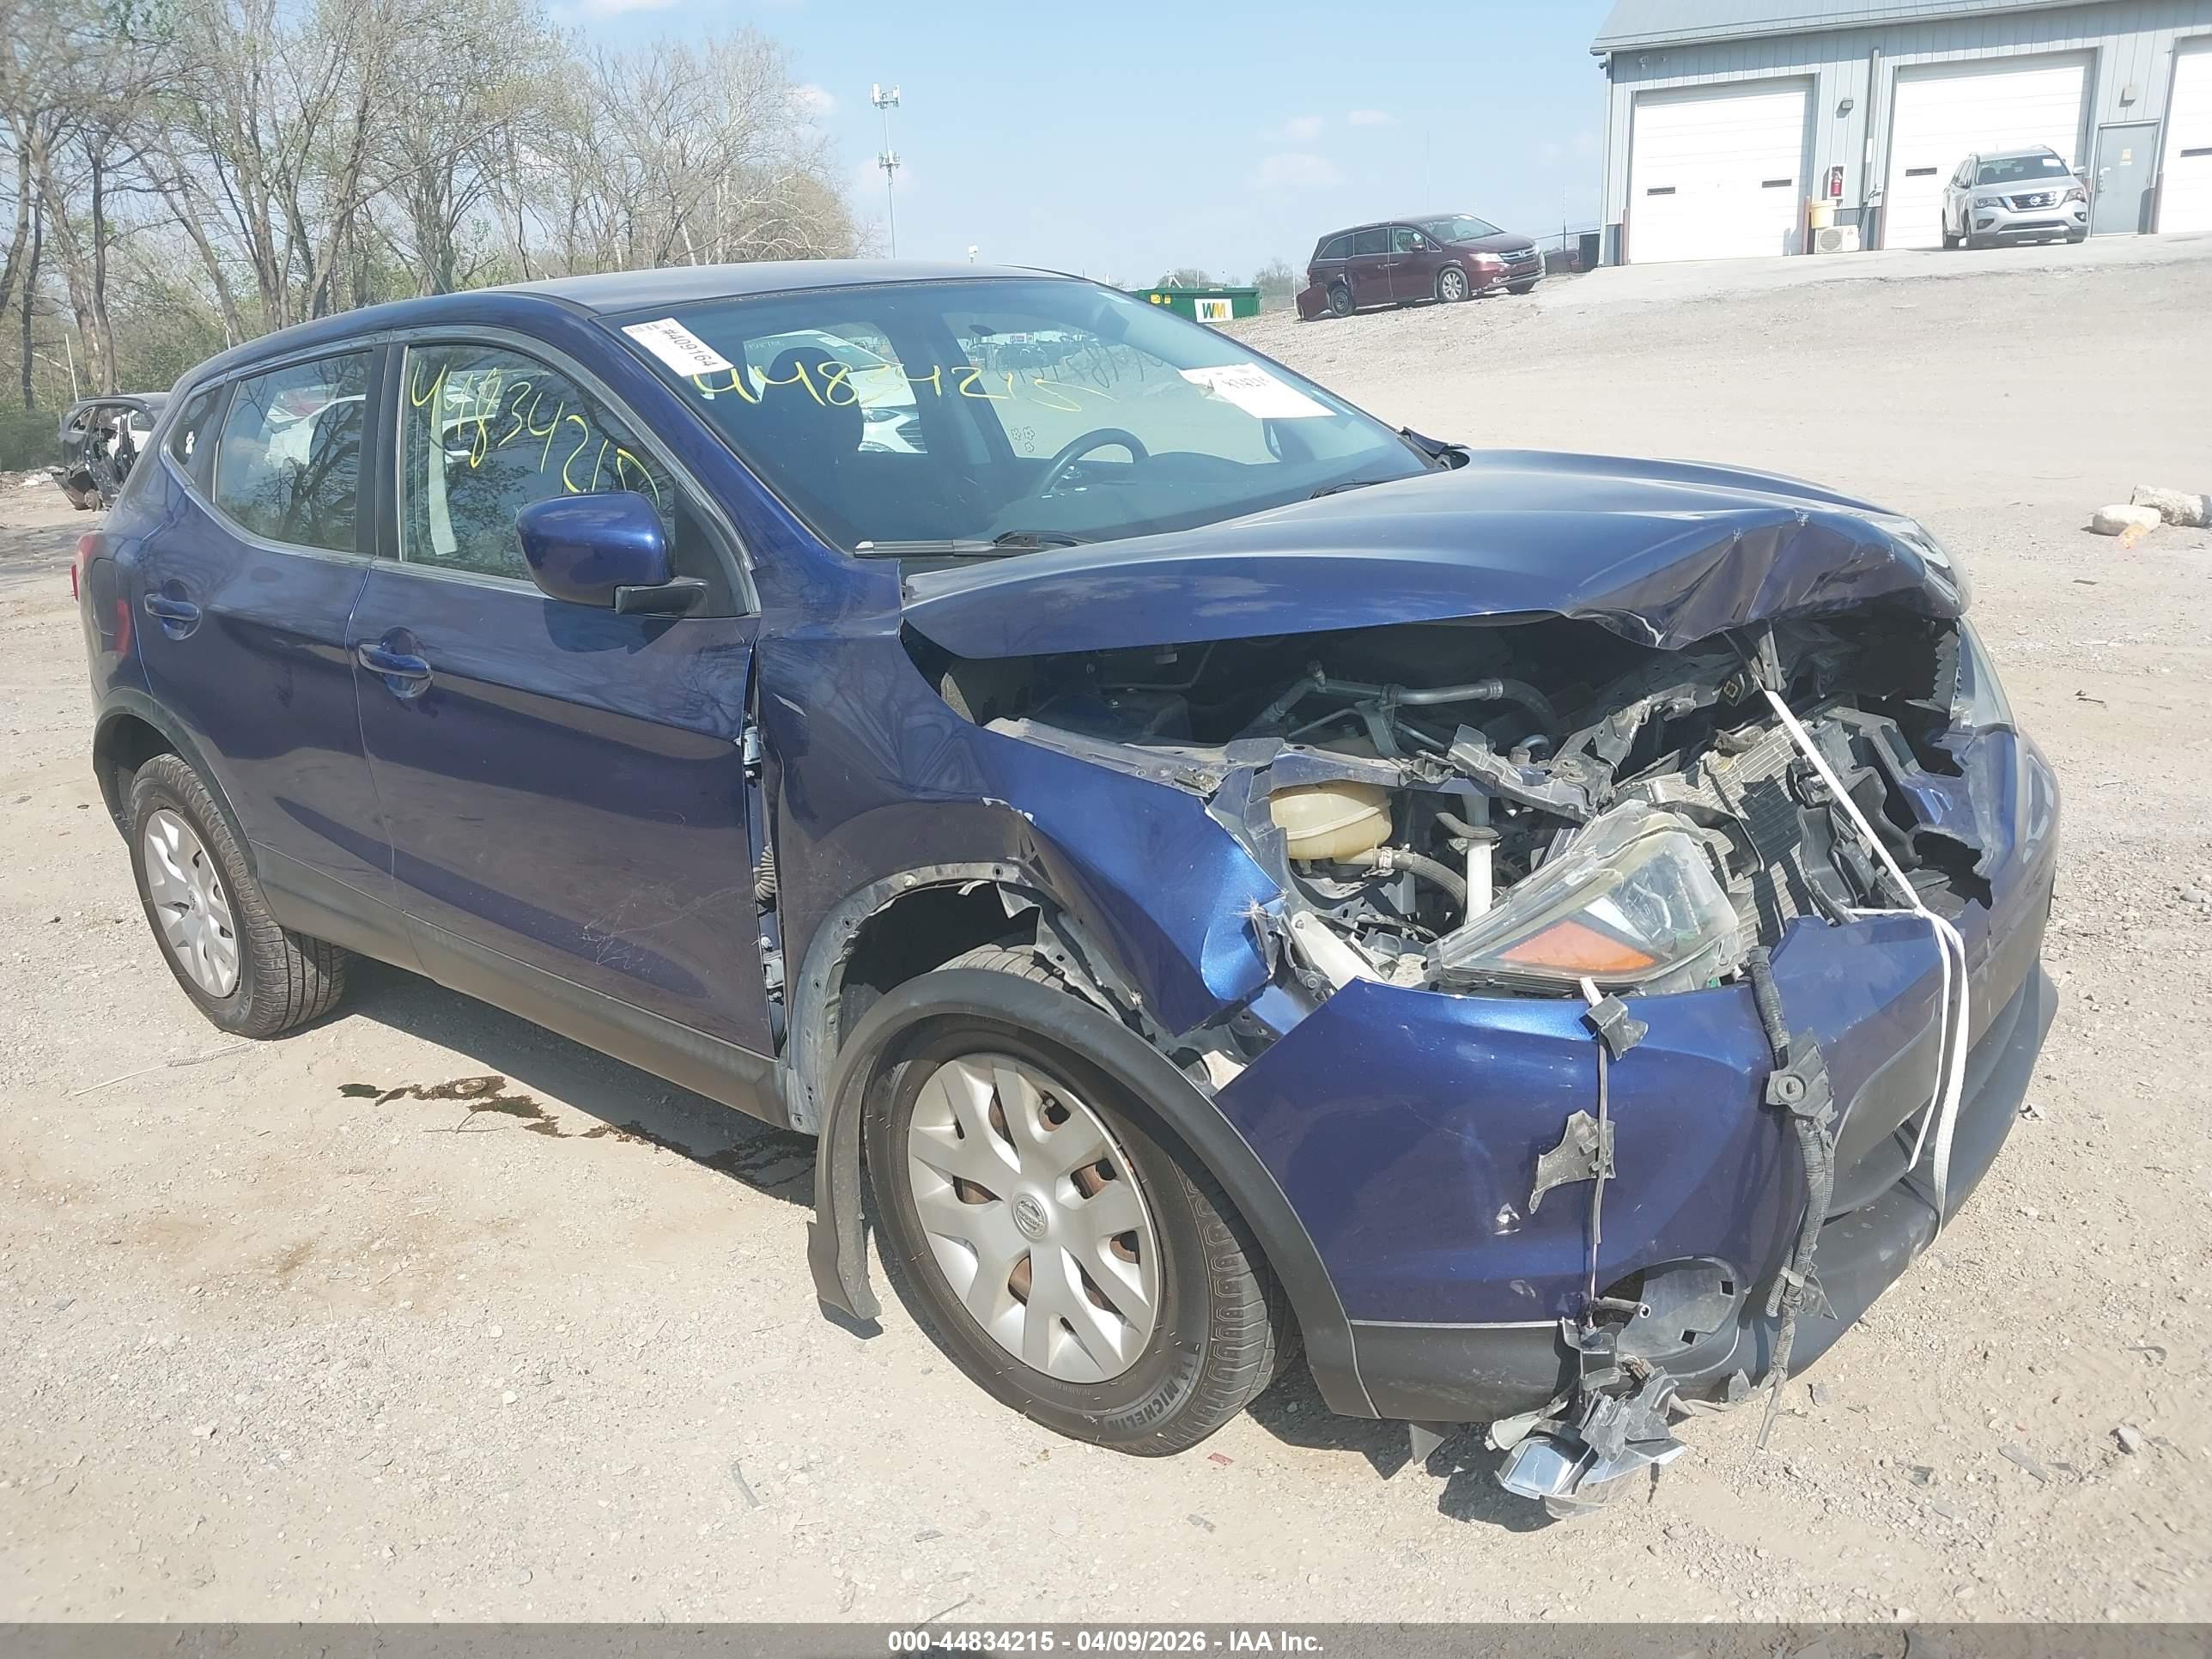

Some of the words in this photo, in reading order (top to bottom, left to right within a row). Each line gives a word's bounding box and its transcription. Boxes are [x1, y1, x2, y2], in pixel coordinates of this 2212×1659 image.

[1202, 302, 1226, 319] WM
[662, 328, 720, 368] #409164
[1107, 1379, 1181, 1430] MICHELIN
